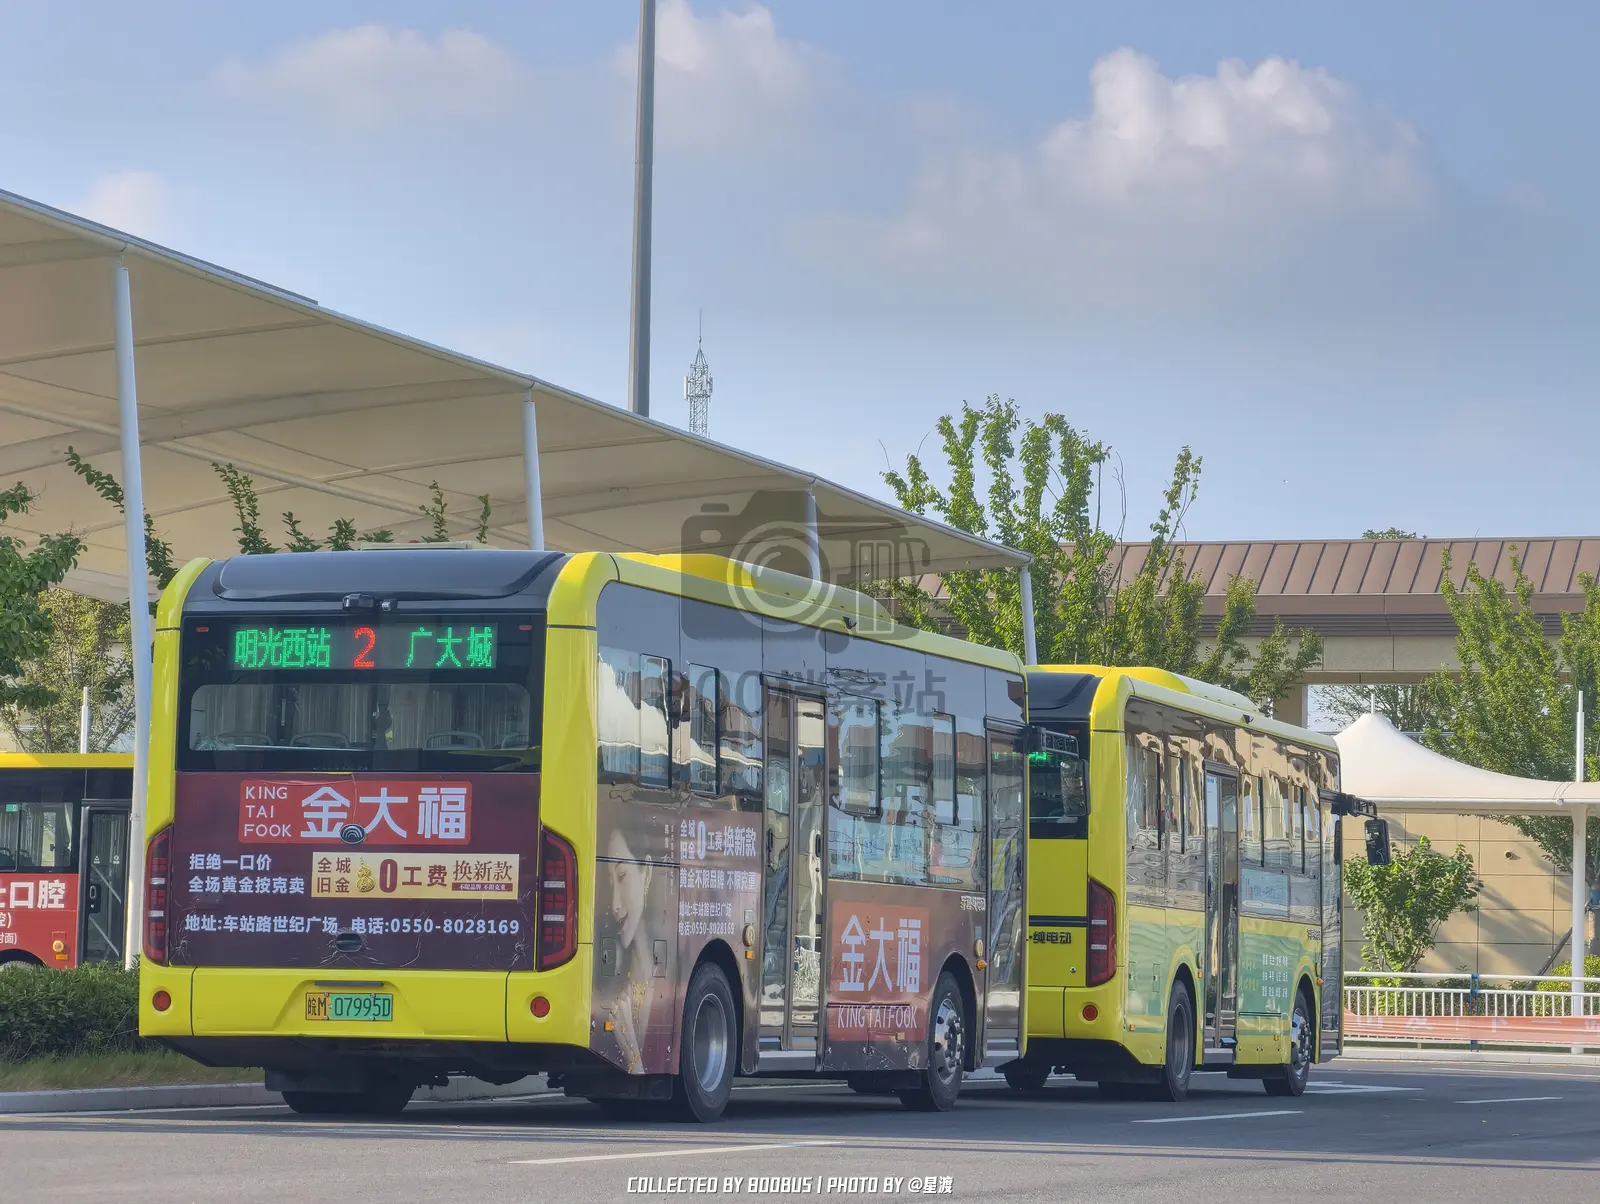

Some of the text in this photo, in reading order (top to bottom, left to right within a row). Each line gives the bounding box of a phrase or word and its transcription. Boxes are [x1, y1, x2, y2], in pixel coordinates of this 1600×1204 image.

[234, 626, 493, 668] 明光西站 2 广大城
[245, 786, 288, 800] KING
[245, 805, 275, 818] TAI
[300, 786, 467, 839] 金大福
[244, 823, 292, 837] FOOK
[189, 853, 272, 871] 拒绝一口价
[317, 857, 351, 874] 全城
[0, 879, 66, 909] 口腔
[188, 875, 305, 894] 全场黄金按克卖
[317, 877, 350, 893] 旧金
[184, 914, 520, 935] 地址:车站路世纪广场 电话:0550-8028169
[839, 915, 921, 993] 金大福
[837, 1006, 866, 1028] KING
[887, 1006, 918, 1029] FOOK
